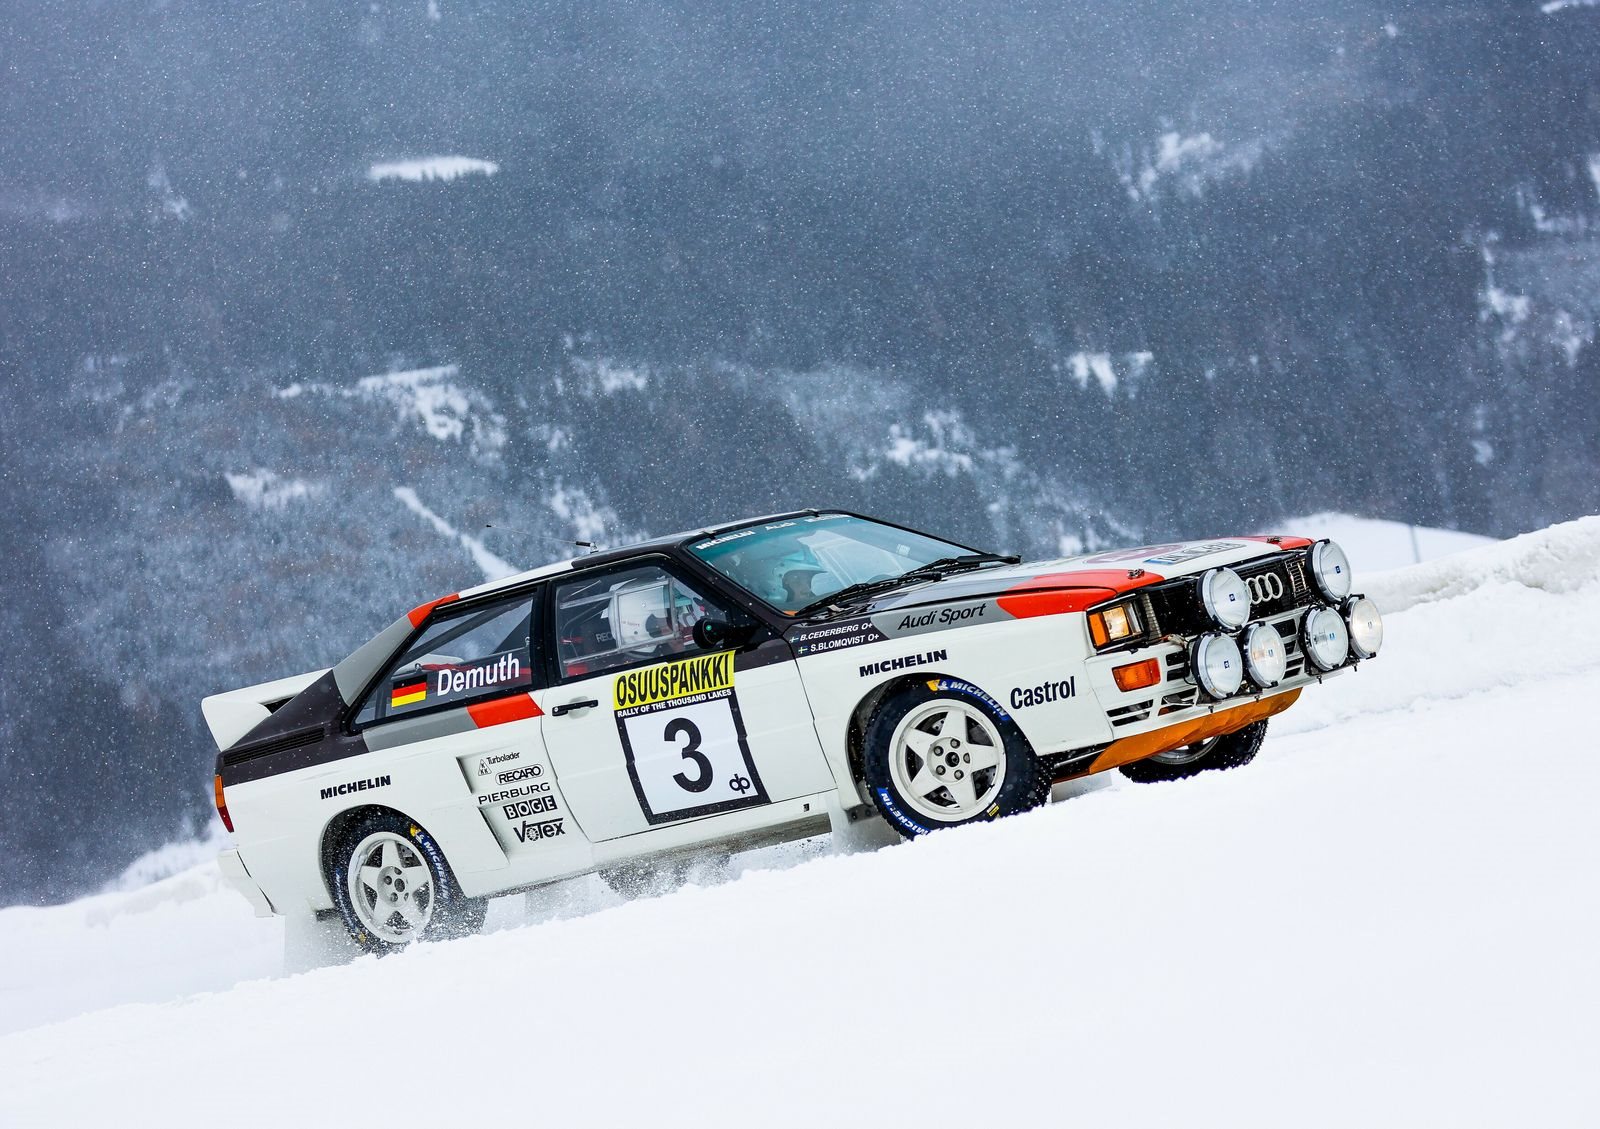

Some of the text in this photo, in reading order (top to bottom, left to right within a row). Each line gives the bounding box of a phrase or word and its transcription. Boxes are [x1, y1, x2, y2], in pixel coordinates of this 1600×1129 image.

[897, 603, 987, 631] Audi Sport
[799, 624, 859, 643] B.CEDERBERG
[810, 635, 865, 653] S.BLOMQVIST
[437, 653, 520, 697] Demuth
[859, 649, 948, 678] MICHELIN
[616, 653, 730, 707] OSUUSPANKKI
[1010, 675, 1076, 710] Castrol
[617, 688, 732, 718] RALLY OF THE THOUSAND LAKES
[950, 681, 1008, 717] MICHELIN
[486, 752, 520, 765] Turbolader
[663, 717, 714, 793] 3
[320, 775, 391, 800] MICHELIN
[498, 765, 541, 784] RECARO
[478, 782, 551, 805] PIERBURG
[504, 795, 556, 819] BOGE
